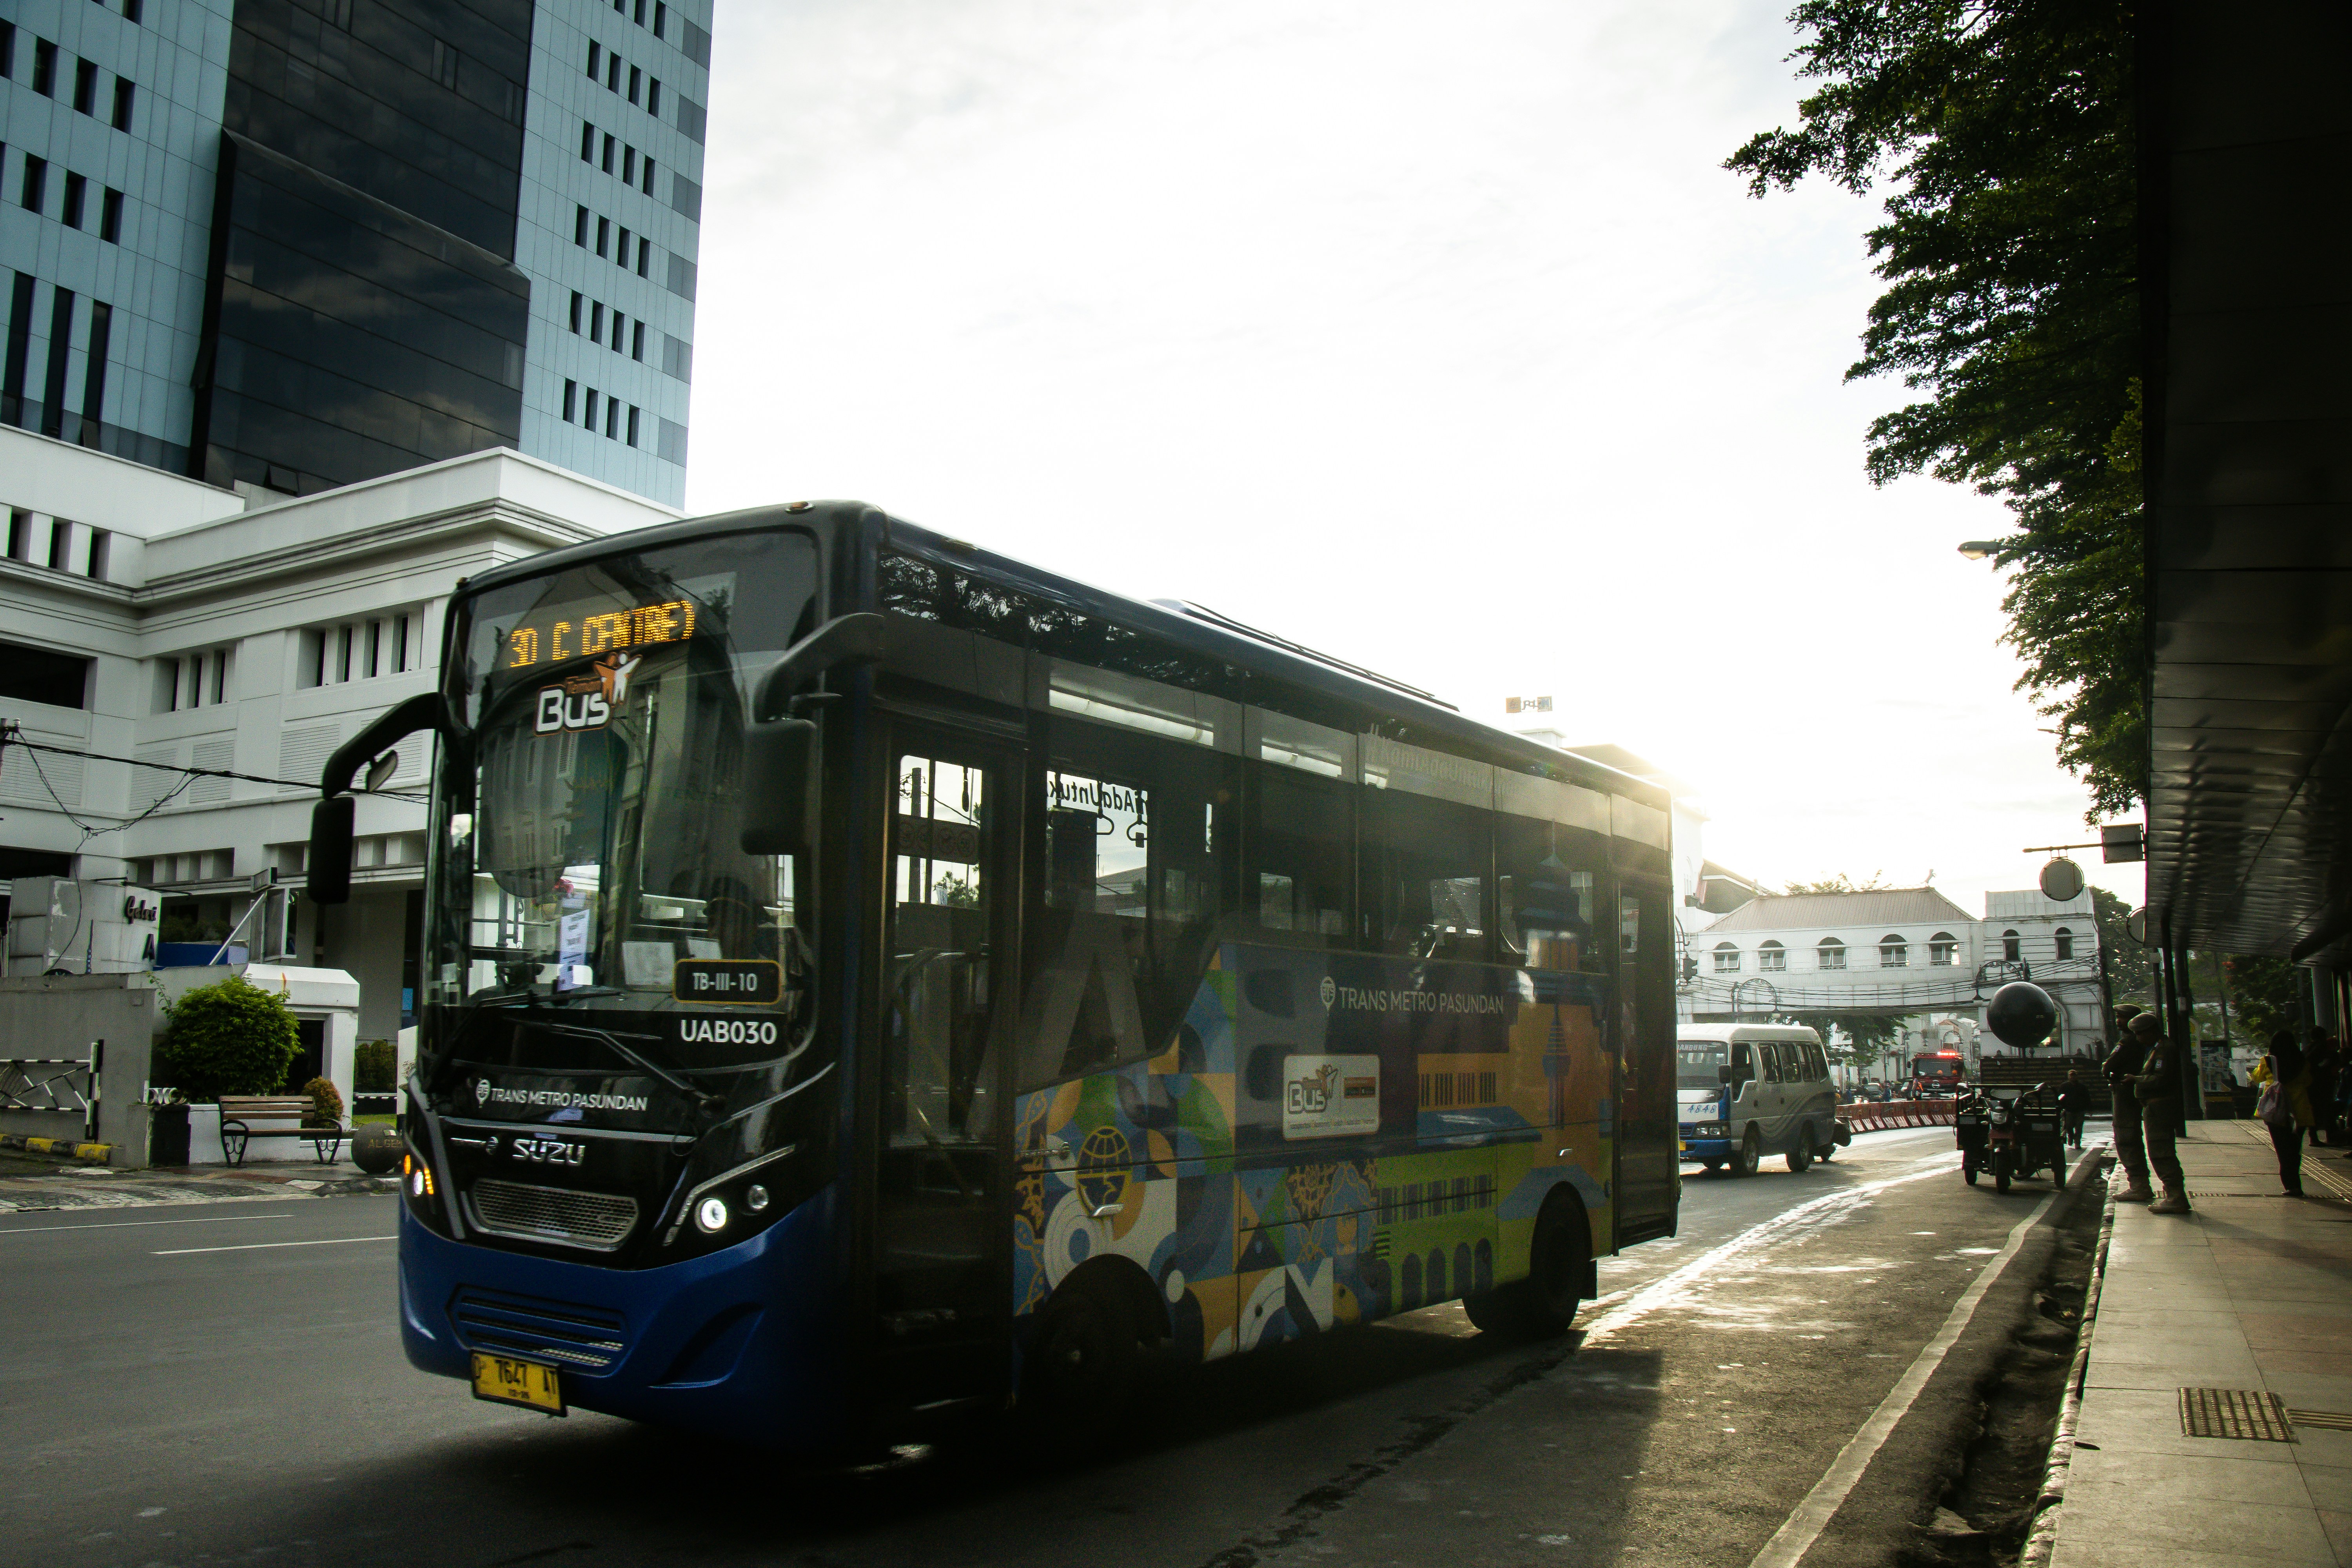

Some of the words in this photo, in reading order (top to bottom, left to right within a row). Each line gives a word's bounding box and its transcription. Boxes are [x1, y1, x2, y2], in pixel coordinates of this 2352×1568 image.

[535, 689, 610, 732] Bus
[1339, 987, 1387, 1011] TRANS
[1390, 991, 1436, 1011] METRO
[1439, 993, 1504, 1014] PASUNDAN
[681, 1020, 777, 1044] UAB030
[491, 1088, 528, 1103] TRANS
[528, 1091, 571, 1107] METRO
[571, 1093, 648, 1111] PASUNDAN
[1289, 1083, 1325, 1112] Bus
